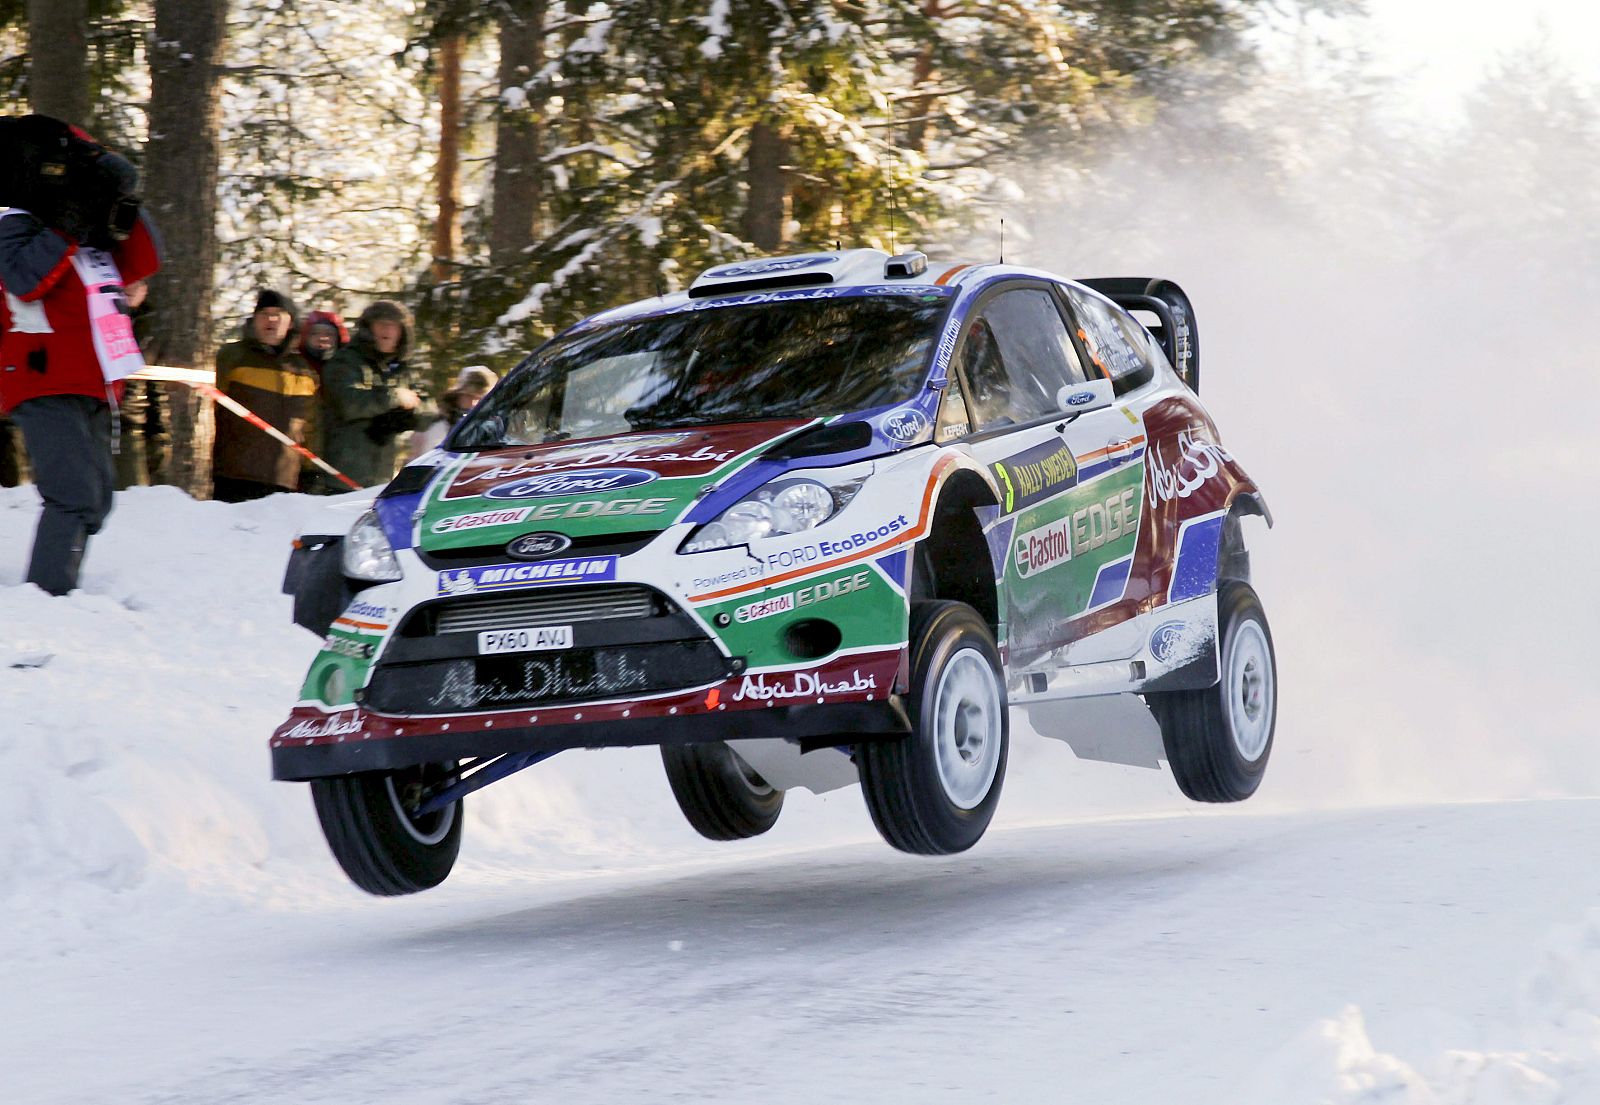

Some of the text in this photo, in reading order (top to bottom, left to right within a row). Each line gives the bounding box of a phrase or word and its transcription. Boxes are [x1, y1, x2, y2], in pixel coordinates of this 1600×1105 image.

[1070, 392, 1092, 405] Ford
[889, 414, 921, 439] Ford
[510, 471, 629, 497] Ford
[1013, 445, 1076, 498] RALLY SWEDEN
[455, 497, 677, 529] Castrol EDGE
[1029, 488, 1138, 570] Castrol EDGE
[518, 537, 556, 553] Ford
[692, 514, 909, 589] Powered by FORD EcoBoost
[478, 560, 611, 584] MICHELIN
[750, 569, 872, 618] Castrol EDGE
[486, 629, 567, 650] PX60 AVJ
